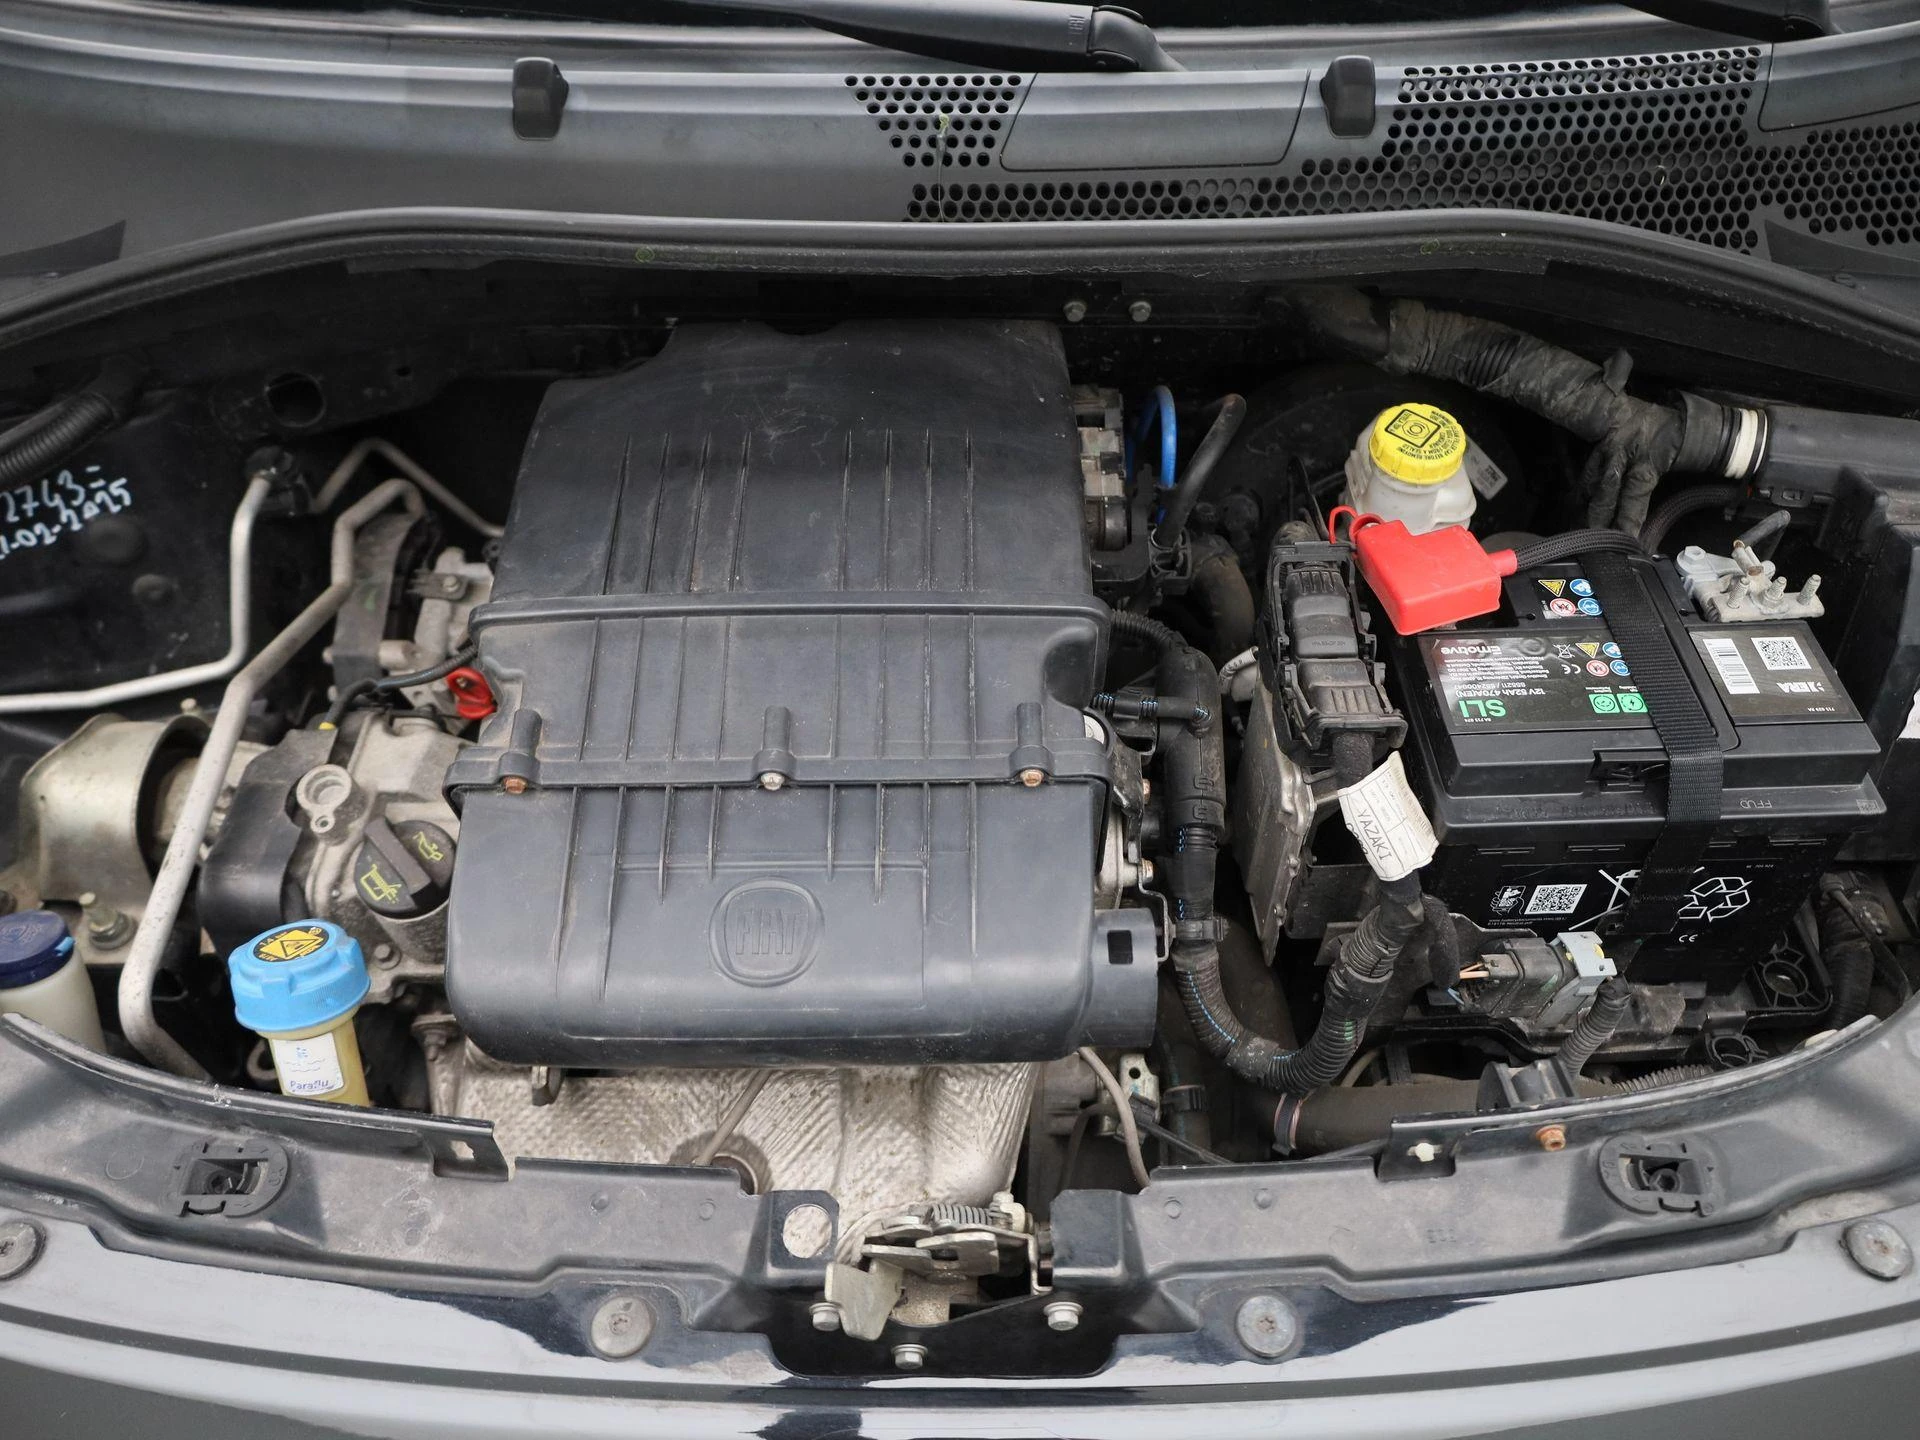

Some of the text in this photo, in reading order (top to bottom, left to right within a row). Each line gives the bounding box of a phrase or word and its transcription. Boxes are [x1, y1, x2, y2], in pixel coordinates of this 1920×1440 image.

[1440, 645, 1502, 656] Emotive
[1458, 699, 1507, 718] SLI
[1357, 809, 1392, 861] YAZAKI
